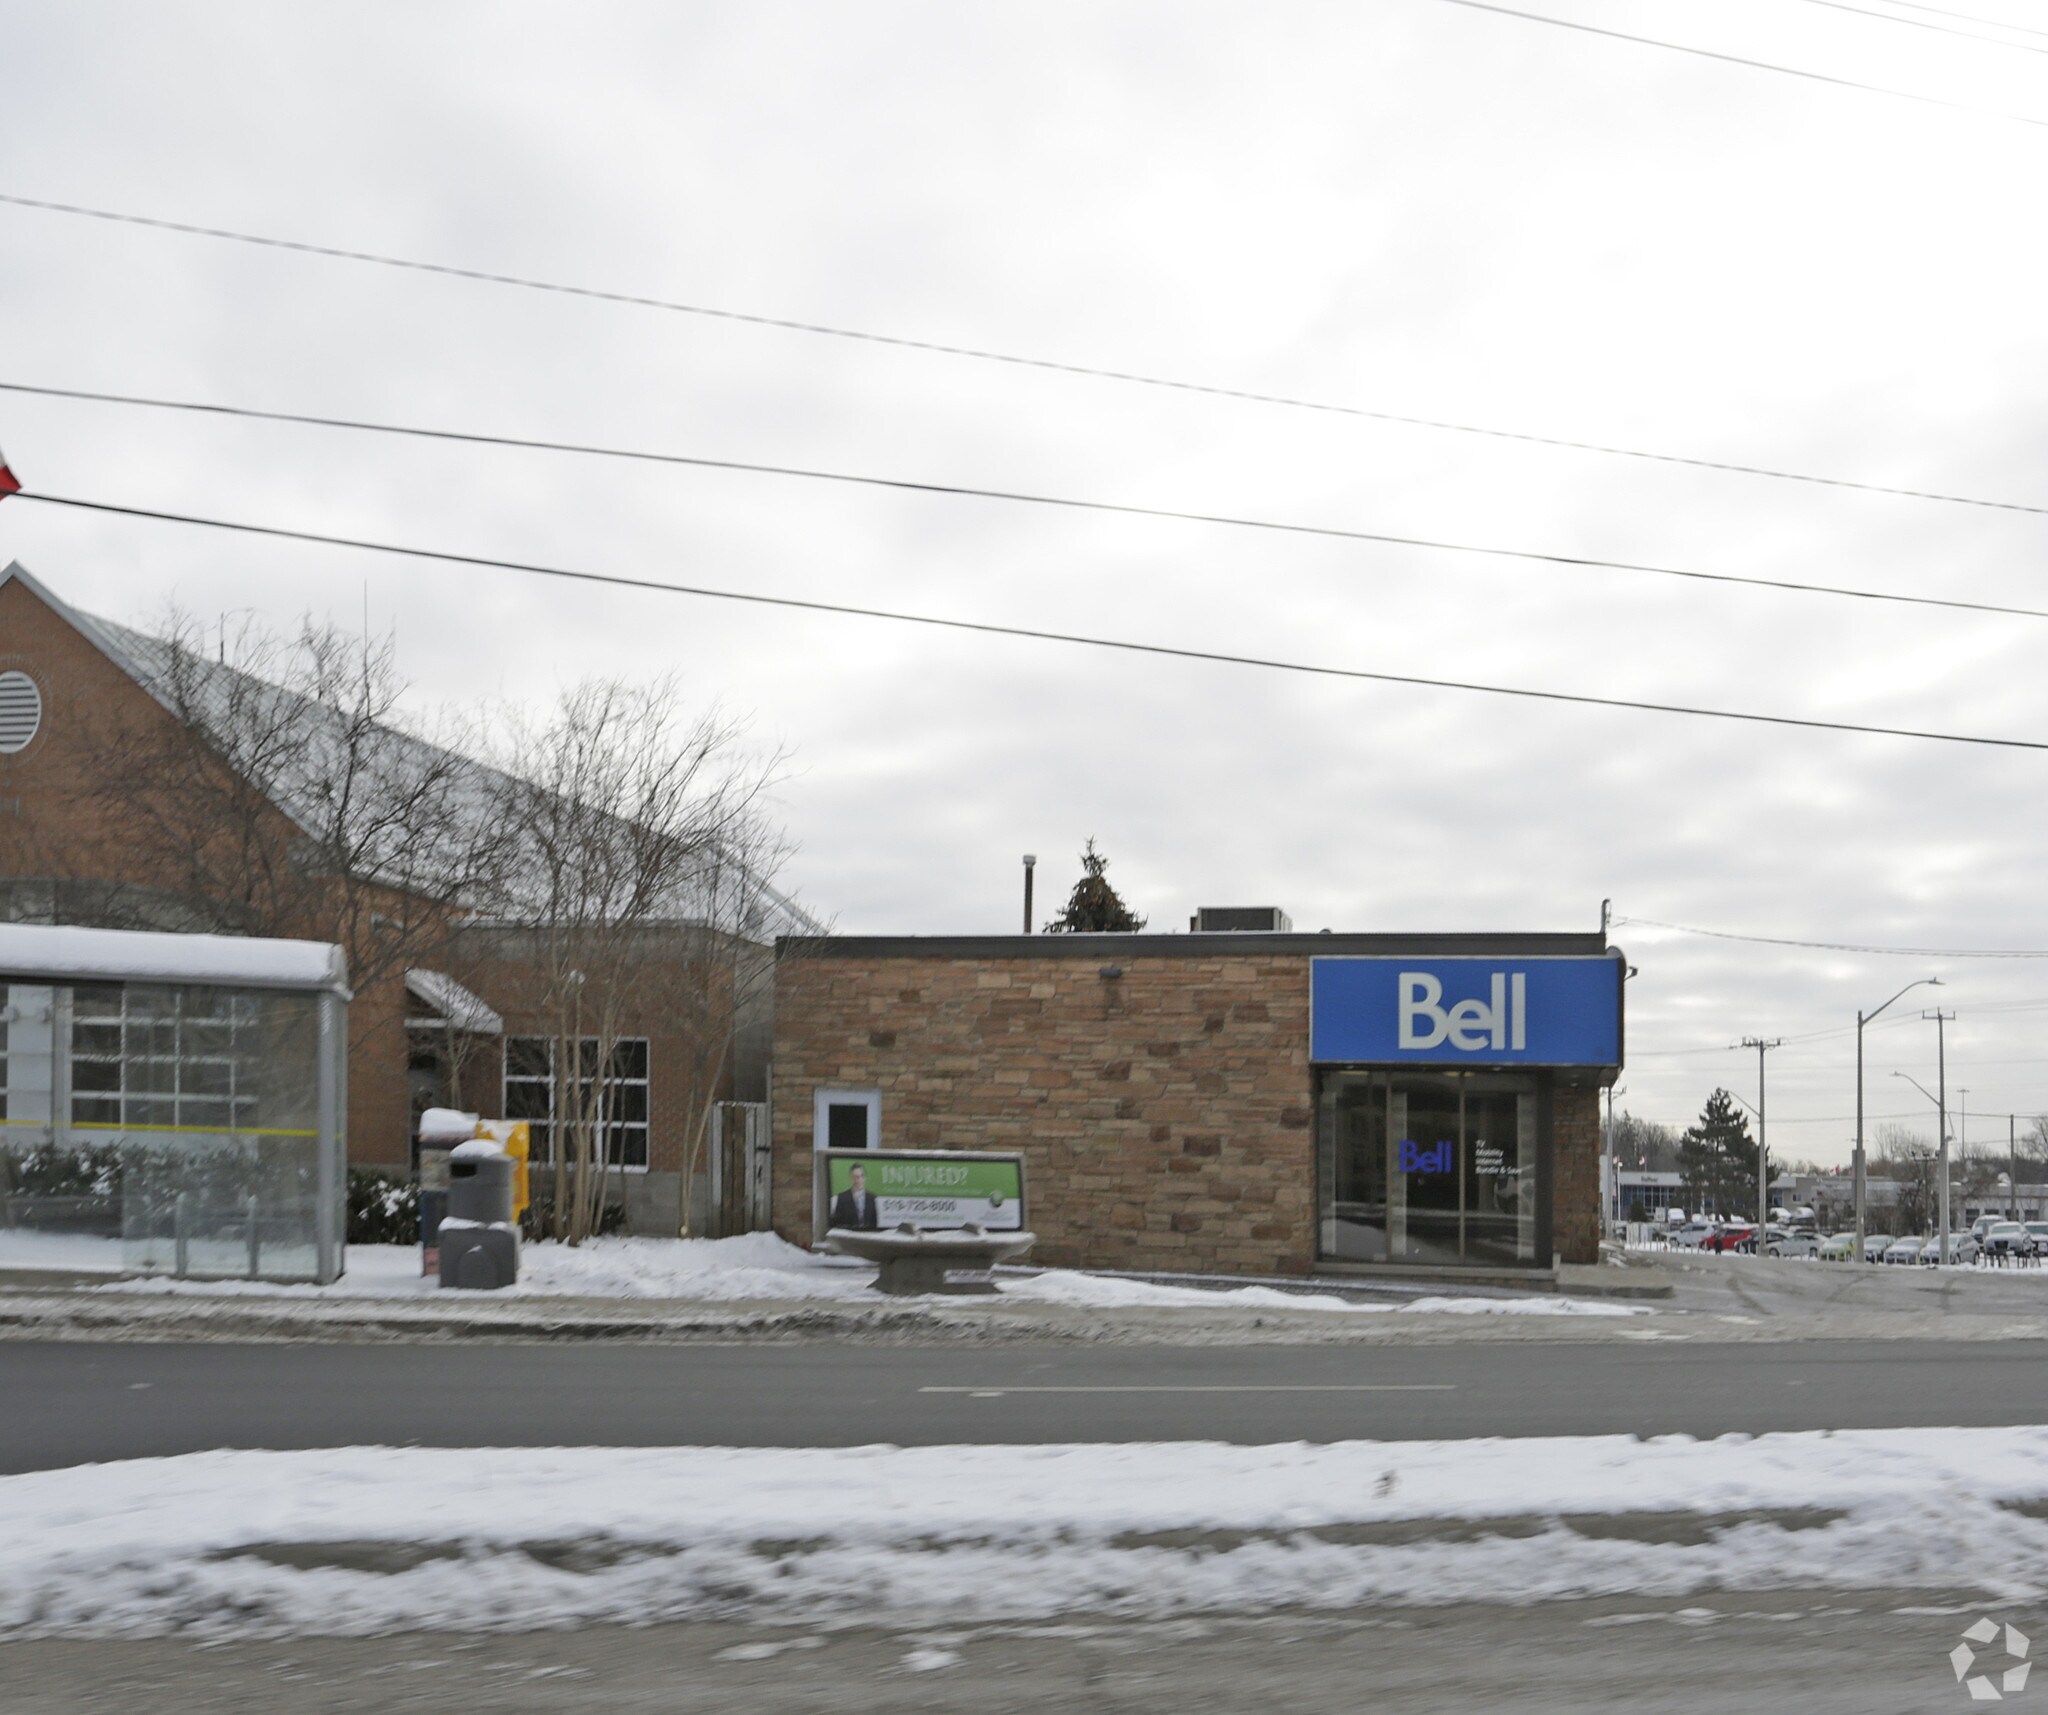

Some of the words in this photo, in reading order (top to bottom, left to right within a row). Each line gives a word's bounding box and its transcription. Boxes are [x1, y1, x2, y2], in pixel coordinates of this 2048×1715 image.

[1398, 972, 1526, 1051] Bell
[1399, 1140, 1453, 1174] Bell
[1475, 1149, 1504, 1157] Mobility
[881, 1165, 969, 1187] INJURED?
